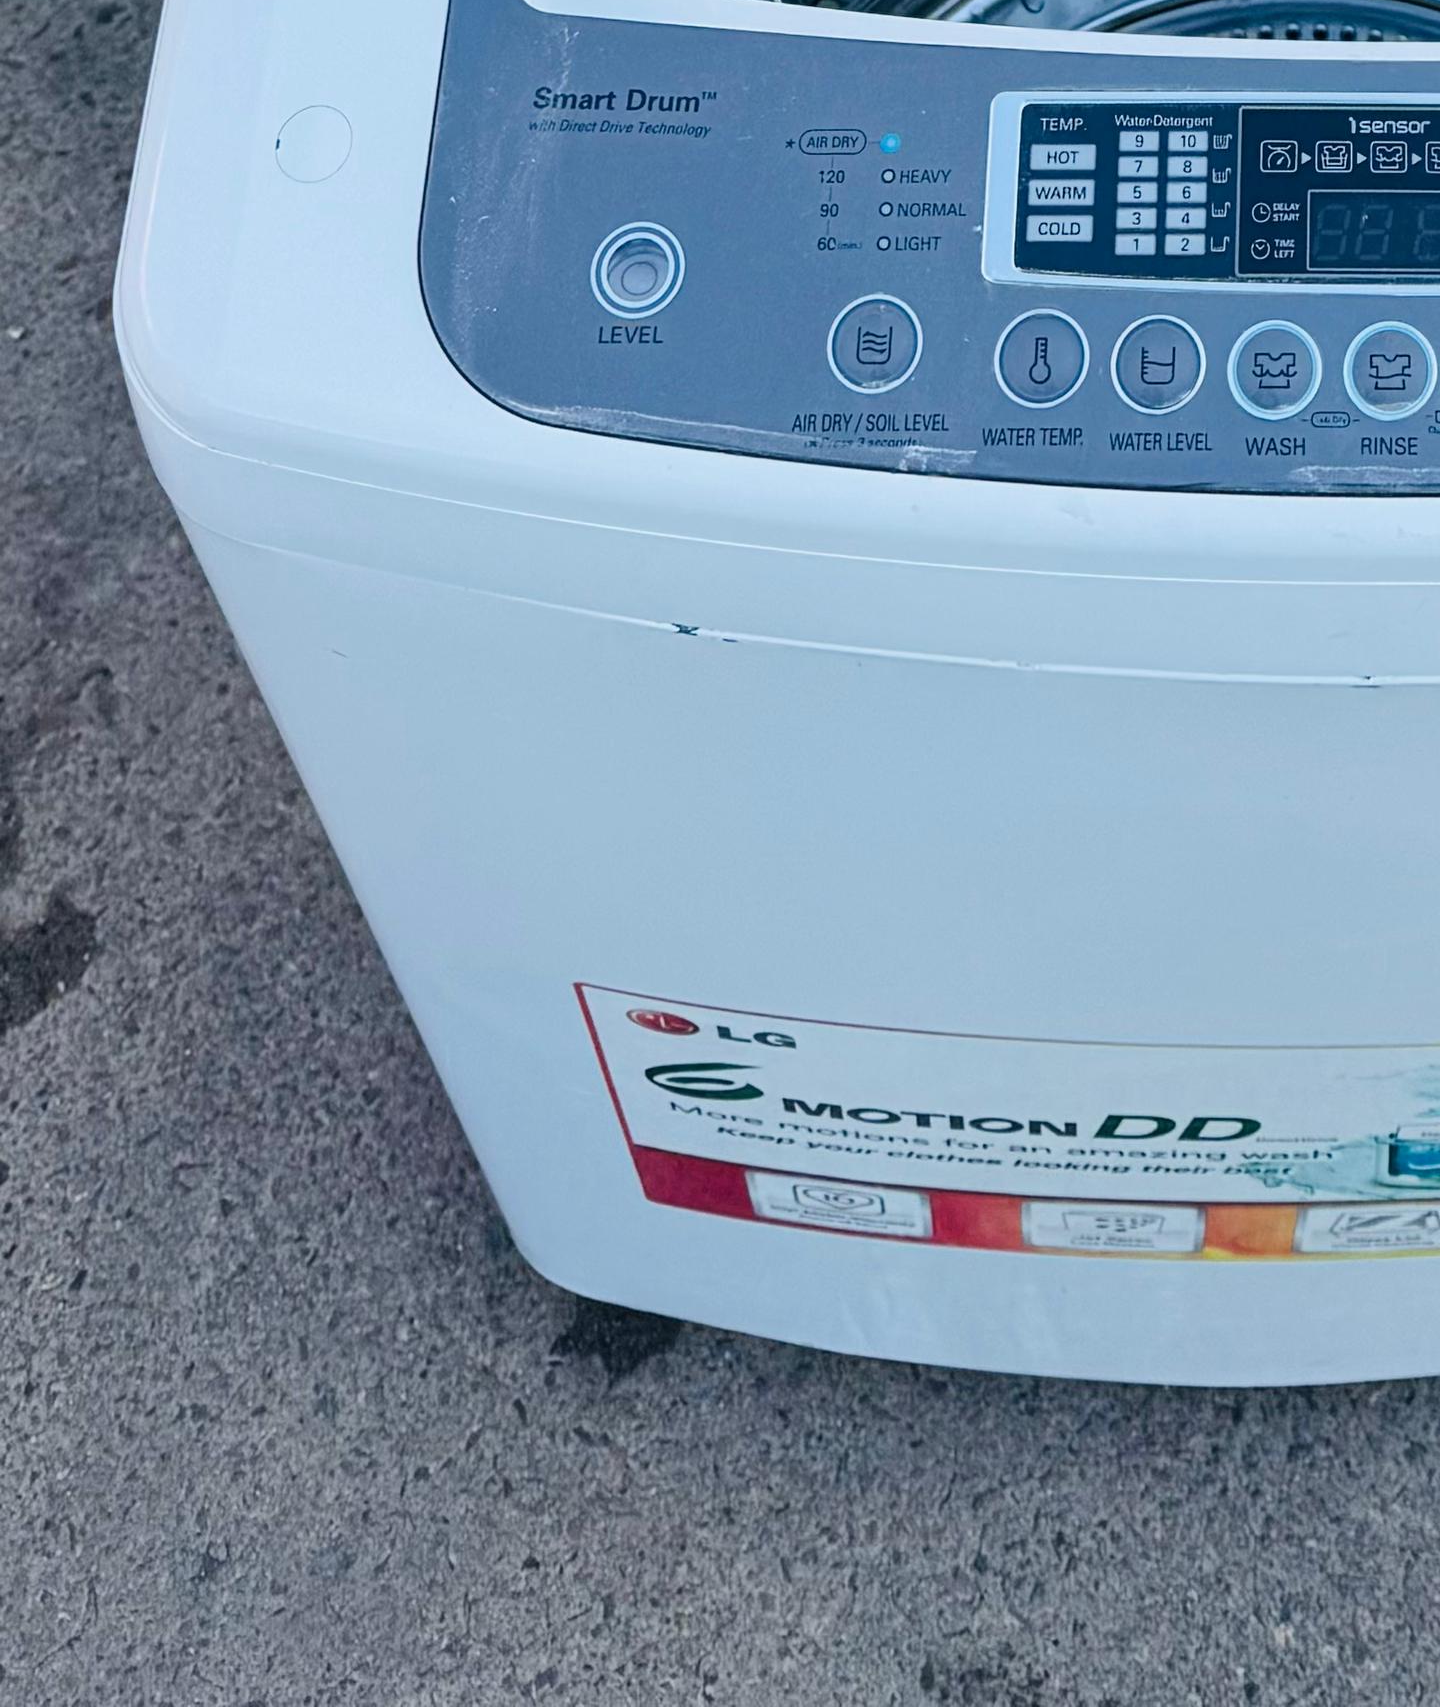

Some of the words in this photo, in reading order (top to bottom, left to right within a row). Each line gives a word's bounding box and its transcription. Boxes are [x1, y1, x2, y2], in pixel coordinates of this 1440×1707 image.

[533, 86, 617, 110] Smart
[559, 119, 597, 133] Direct
[600, 120, 634, 133] Drive
[638, 121, 712, 138] Technology
[1040, 118, 1087, 131] TEMP.
[806, 136, 828, 148] AIR
[832, 137, 859, 149] DRY
[1135, 135, 1144, 147] 9
[1181, 135, 1196, 147] 10
[1047, 151, 1078, 165] HOT
[1134, 160, 1143, 172] 7
[1183, 160, 1192, 173] 8
[819, 170, 845, 184] 120
[899, 169, 951, 184] HEAVY
[1035, 186, 1086, 200] WARM
[1133, 187, 1141, 199] 5
[1182, 187, 1191, 199] 6
[820, 203, 839, 217] 90
[897, 203, 966, 217] NORMAL
[1273, 203, 1300, 211] DELAY
[1132, 213, 1141, 225] 3
[1181, 212, 1190, 224] 4
[1273, 213, 1299, 221] START
[1038, 222, 1080, 235] COLD
[895, 237, 941, 251] LIGHT
[1133, 239, 1139, 251] 1
[1180, 239, 1190, 252] 2
[598, 326, 664, 344] LEVEL
[792, 414, 817, 432] AIR
[821, 414, 852, 432] DRY
[866, 414, 899, 431] SOIL
[904, 414, 949, 431] LEVEL
[982, 428, 1036, 446] WATER
[1040, 428, 1084, 445] TEMP.
[1110, 433, 1163, 451] WATER
[1167, 434, 1212, 451] LEVEL
[1245, 437, 1306, 456] WASH
[1360, 438, 1418, 455] RINSE
[717, 1025, 797, 1049] LG
[782, 1097, 1077, 1139] MOTION
[1094, 1114, 1262, 1141] DD
[670, 1101, 764, 1126] More
[779, 1122, 929, 1147] motions
[946, 1138, 995, 1150] for
[1009, 1144, 1052, 1154] an
[1067, 1147, 1227, 1161] amazing
[1241, 1150, 1332, 1160] wash
[717, 1127, 796, 1145] Keep
[807, 1141, 879, 1156] your
[887, 1150, 1003, 1166] clothes
[1014, 1159, 1130, 1174] looking
[1143, 1164, 1217, 1175] their
